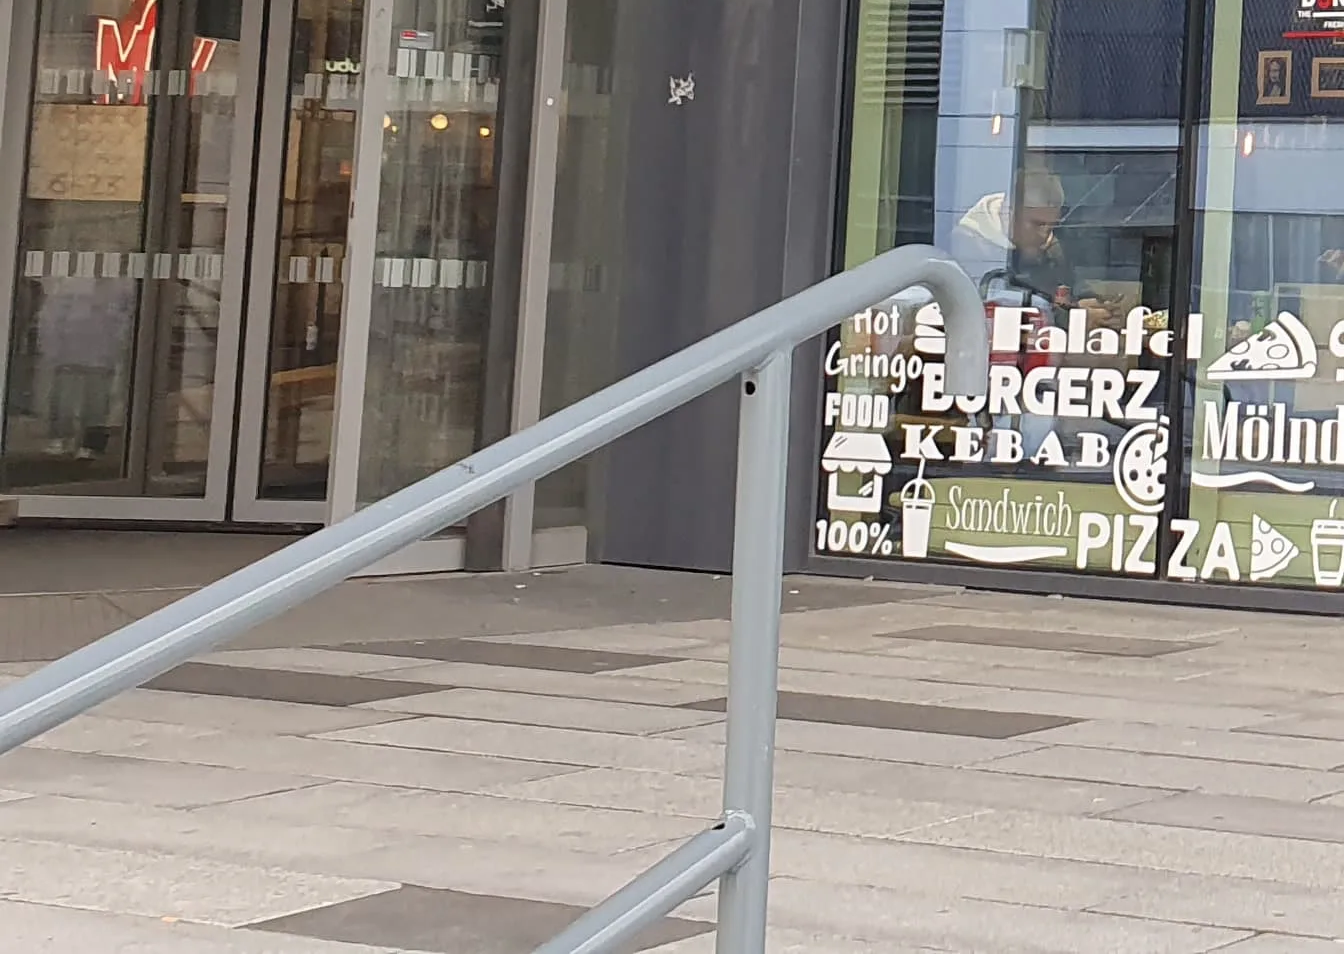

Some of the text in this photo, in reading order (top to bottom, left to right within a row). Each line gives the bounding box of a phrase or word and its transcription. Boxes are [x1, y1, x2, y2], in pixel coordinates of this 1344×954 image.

[853, 304, 900, 336] Hot
[992, 306, 1203, 360] Falafel
[824, 340, 923, 393] Gringo
[824, 392, 890, 429] FOOD
[900, 423, 1111, 468] KEBAB
[944, 485, 1073, 538] Sandwich
[815, 519, 894, 556] 100%
[1076, 512, 1240, 581] PIZZA
